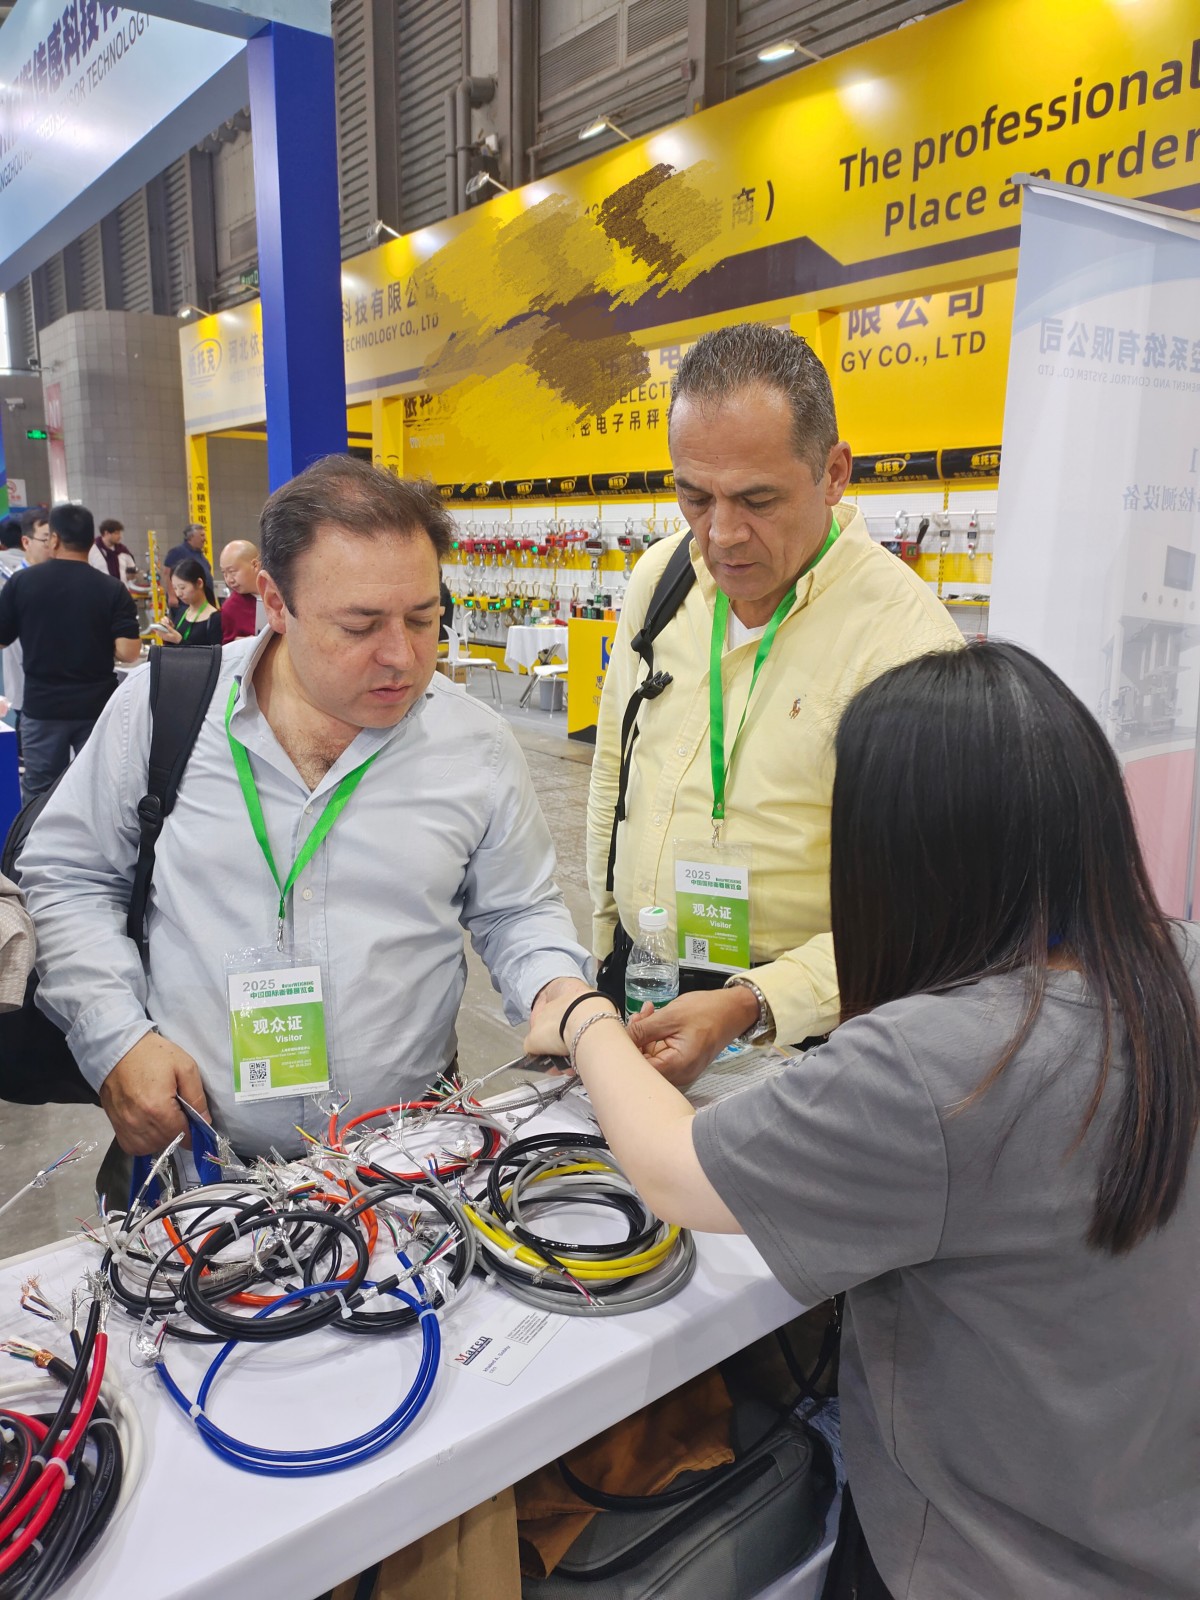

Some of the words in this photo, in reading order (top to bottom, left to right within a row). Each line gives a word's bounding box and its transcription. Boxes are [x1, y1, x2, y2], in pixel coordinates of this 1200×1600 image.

[839, 146, 902, 192] The
[912, 39, 1200, 182] professional
[0, 154, 23, 193] NGZHOU
[885, 183, 987, 237] Place
[343, 323, 398, 353] ECHNOLOGY
[841, 348, 872, 373] GY
[878, 342, 928, 367] CO.,
[936, 330, 986, 359] LTD
[619, 380, 677, 404] ELECT
[580, 408, 670, 437] 密电子吊秤
[685, 869, 711, 880] 2025
[692, 903, 732, 920] 观众证
[709, 920, 732, 929] Visitor
[242, 979, 276, 993] 2025
[252, 1015, 303, 1035] 观众证
[275, 1034, 303, 1043] Visitor
[454, 1335, 488, 1365] Maren
